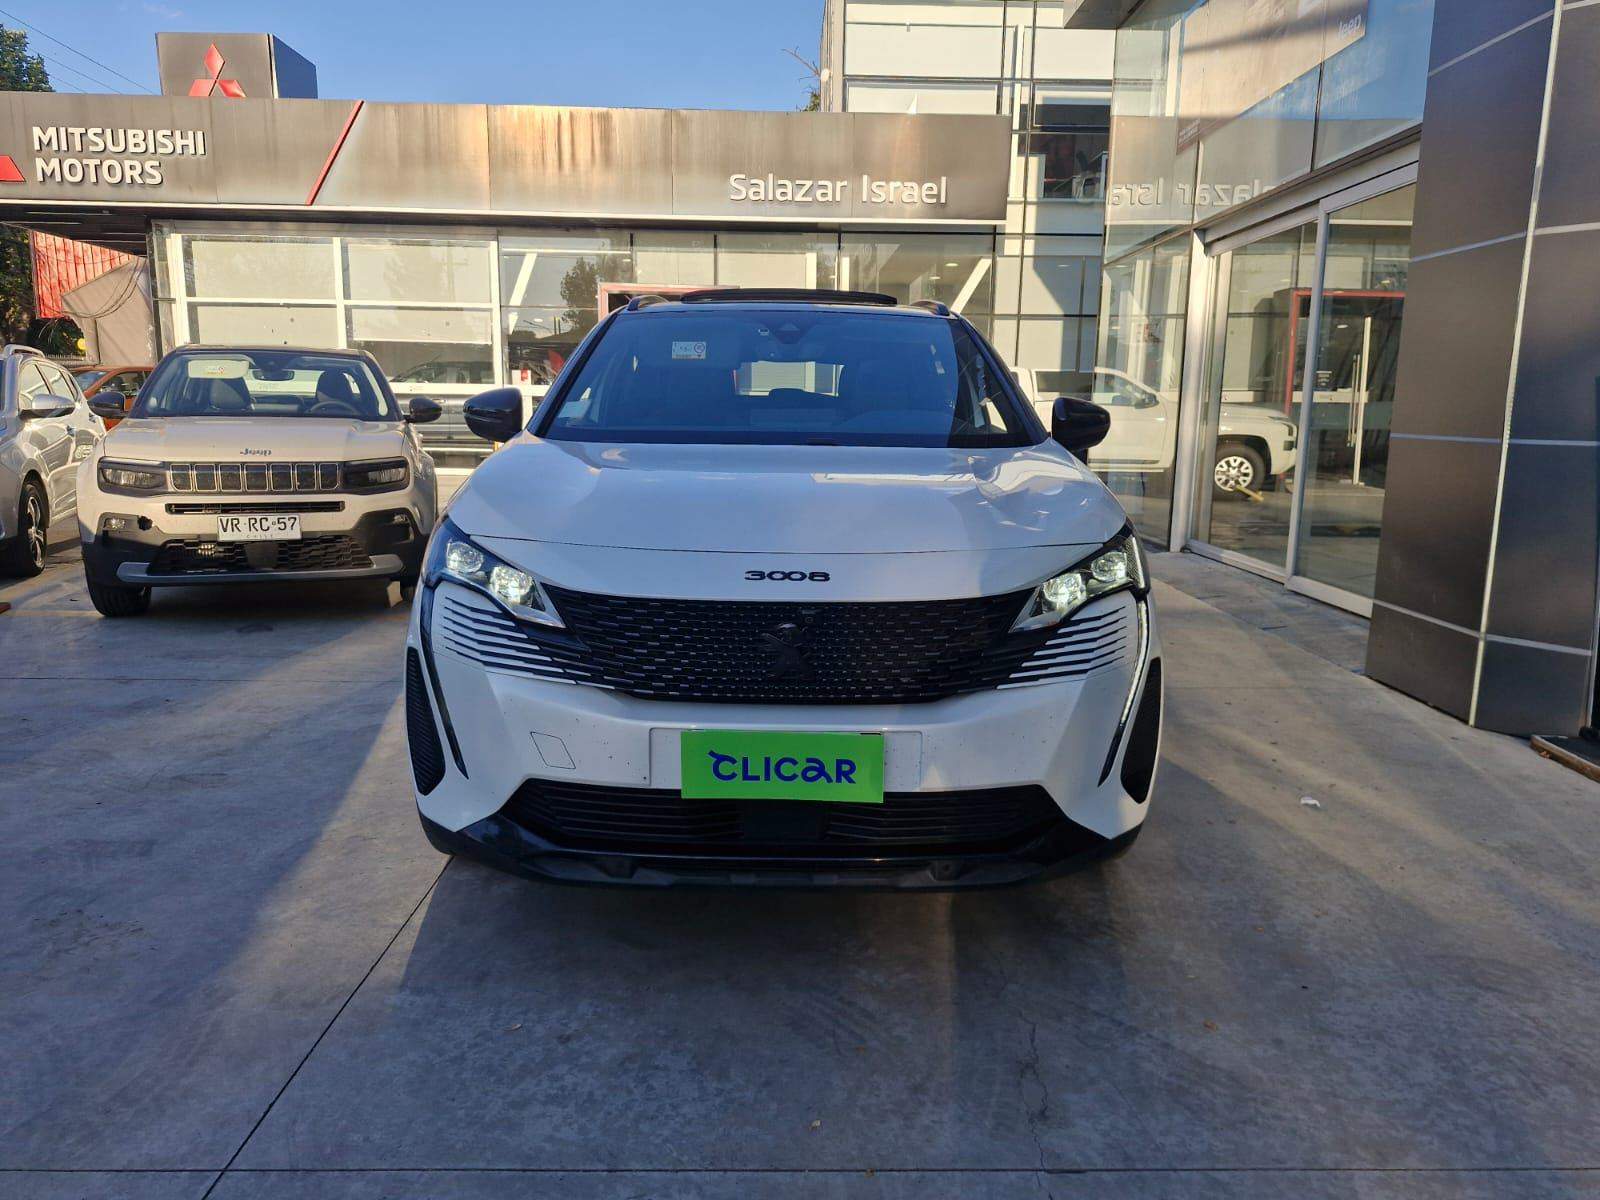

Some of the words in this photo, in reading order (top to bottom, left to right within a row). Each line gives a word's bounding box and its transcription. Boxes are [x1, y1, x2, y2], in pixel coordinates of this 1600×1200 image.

[32, 126, 206, 155] MITSUBISHI
[35, 157, 163, 185] MOTORS
[729, 173, 848, 202] Salazar
[861, 174, 948, 204] Israel
[744, 570, 831, 582] 3008
